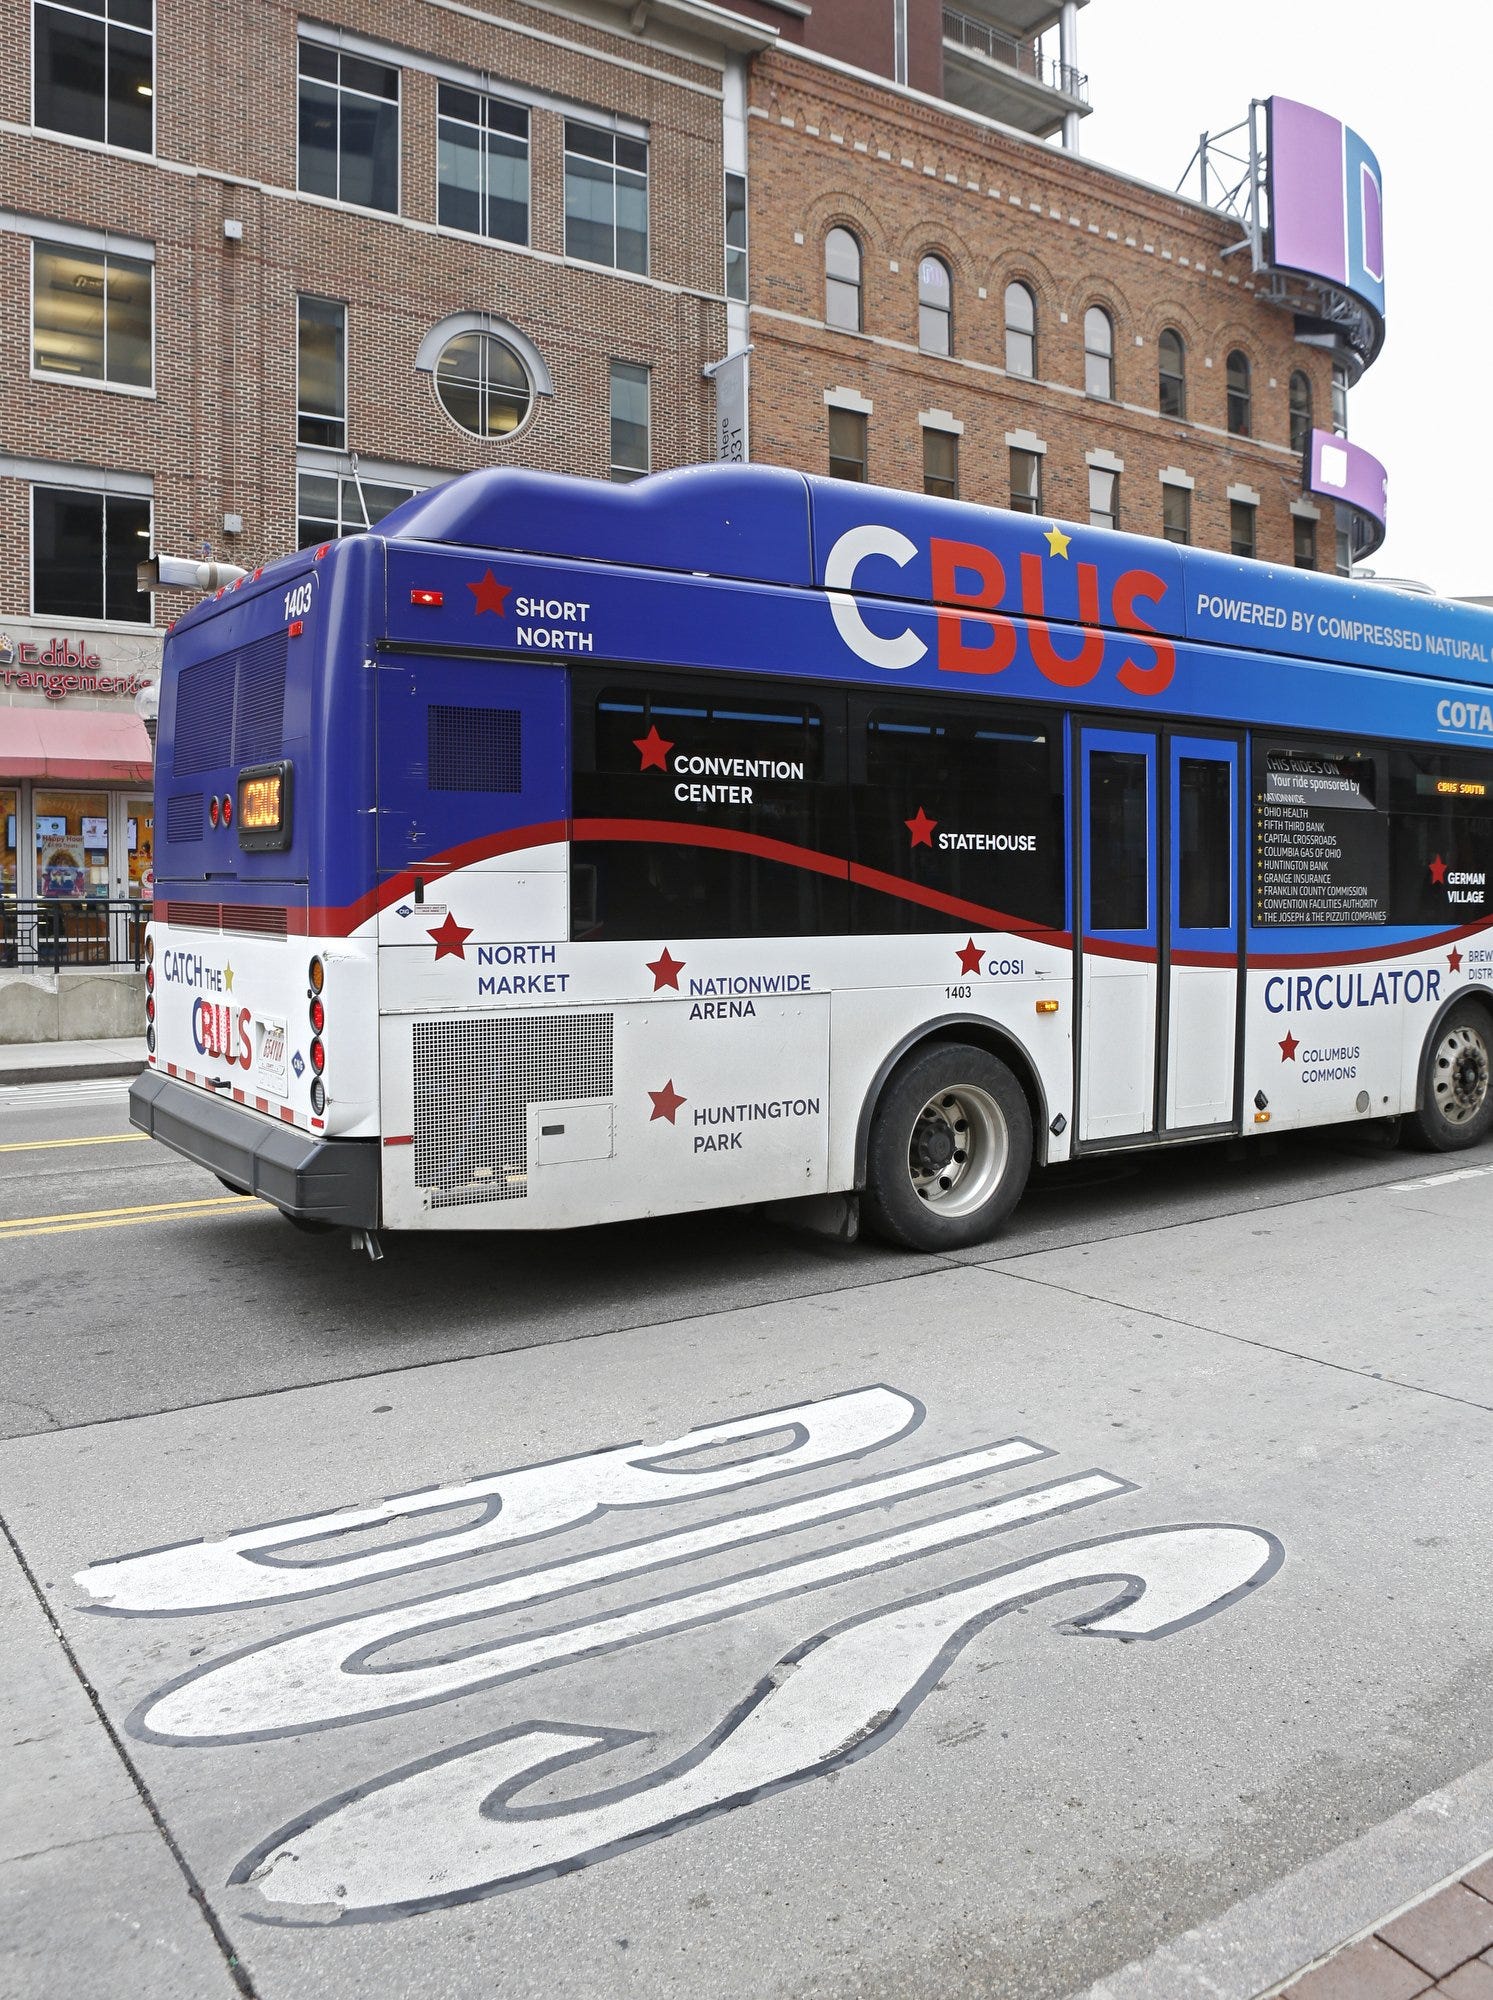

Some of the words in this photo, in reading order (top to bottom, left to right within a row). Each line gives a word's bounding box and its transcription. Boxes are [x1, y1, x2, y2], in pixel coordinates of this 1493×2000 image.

[720, 417, 729, 459] Here
[284, 582, 312, 620] 1403
[515, 596, 591, 622] SHORT
[824, 524, 1175, 697] CBUS
[1196, 593, 1288, 630] POWERED
[1291, 610, 1316, 634] BY
[1317, 616, 1422, 652] COMPRESSED
[1425, 634, 1488, 664] NATURAL
[516, 626, 593, 653] NORTH
[18, 637, 102, 669] Edible
[1436, 699, 1493, 732] COTA
[674, 755, 804, 780] CONVENTION
[1266, 758, 1289, 771] THIS
[1291, 759, 1323, 774] RIDE'S
[1324, 761, 1340, 775] ON
[674, 783, 754, 804] CENTER
[1271, 773, 1291, 787] Your
[1292, 775, 1309, 789] ride
[1309, 778, 1350, 793] sponsored
[1350, 779, 1361, 796] by
[1436, 781, 1458, 793] CBUS
[1459, 783, 1486, 796] SOUTH
[1263, 793, 1307, 804] NATIONWIDE
[1263, 806, 1282, 818] OHIO
[1282, 808, 1309, 819] HEALTH
[1263, 820, 1284, 831] FIFTH
[1284, 821, 1305, 832] THIRD
[1305, 822, 1326, 833] BANK
[938, 833, 1037, 851] STATEHOUSE
[1263, 832, 1292, 844] CAPITAL
[1292, 834, 1338, 846] CROSSROADS
[1263, 846, 1300, 857] COLUMBIA
[1300, 847, 1315, 858] GAS
[1314, 848, 1325, 858] OF
[1324, 848, 1342, 859] OHIO
[1263, 860, 1309, 871] HUNTINGTON
[1309, 861, 1329, 871] BANK
[1263, 872, 1293, 883] GRANGE
[1293, 873, 1332, 884] INSURANCE
[1447, 872, 1486, 885] GERMAN
[1263, 885, 1299, 896] FRANKLIN
[1299, 886, 1327, 896] COUNTY
[1326, 886, 1368, 896] COMMISSION
[1447, 890, 1485, 904] VILLAGE
[1263, 898, 1308, 909] CONVENTION
[1308, 898, 1342, 909] FACILITIES
[1342, 898, 1379, 909] AUTHORITY
[1263, 912, 1278, 923] THE
[1278, 912, 1305, 923] JOSEPH
[1305, 912, 1312, 922] &
[1311, 912, 1325, 922] THE
[1325, 912, 1351, 922] PIZZUTI
[1350, 911, 1387, 921] COMPANIES
[477, 945, 557, 966] NORTH
[164, 949, 203, 988] CATCH
[204, 967, 222, 993] THE
[988, 959, 1025, 976] COSI
[1468, 968, 1493, 980] DISTR
[477, 973, 570, 996] MARKET
[688, 973, 812, 996] NATIONWIDE
[944, 985, 973, 1000] 1403
[1264, 969, 1441, 1014] CIRCULATOR
[688, 1000, 757, 1021] ARENA
[1302, 1046, 1360, 1063] COLUMBUS
[1301, 1066, 1357, 1083] COMMONS
[693, 1097, 820, 1127] HUNTINGTON
[693, 1132, 743, 1154] PARK
[70, 1383, 1286, 1928] BUS
